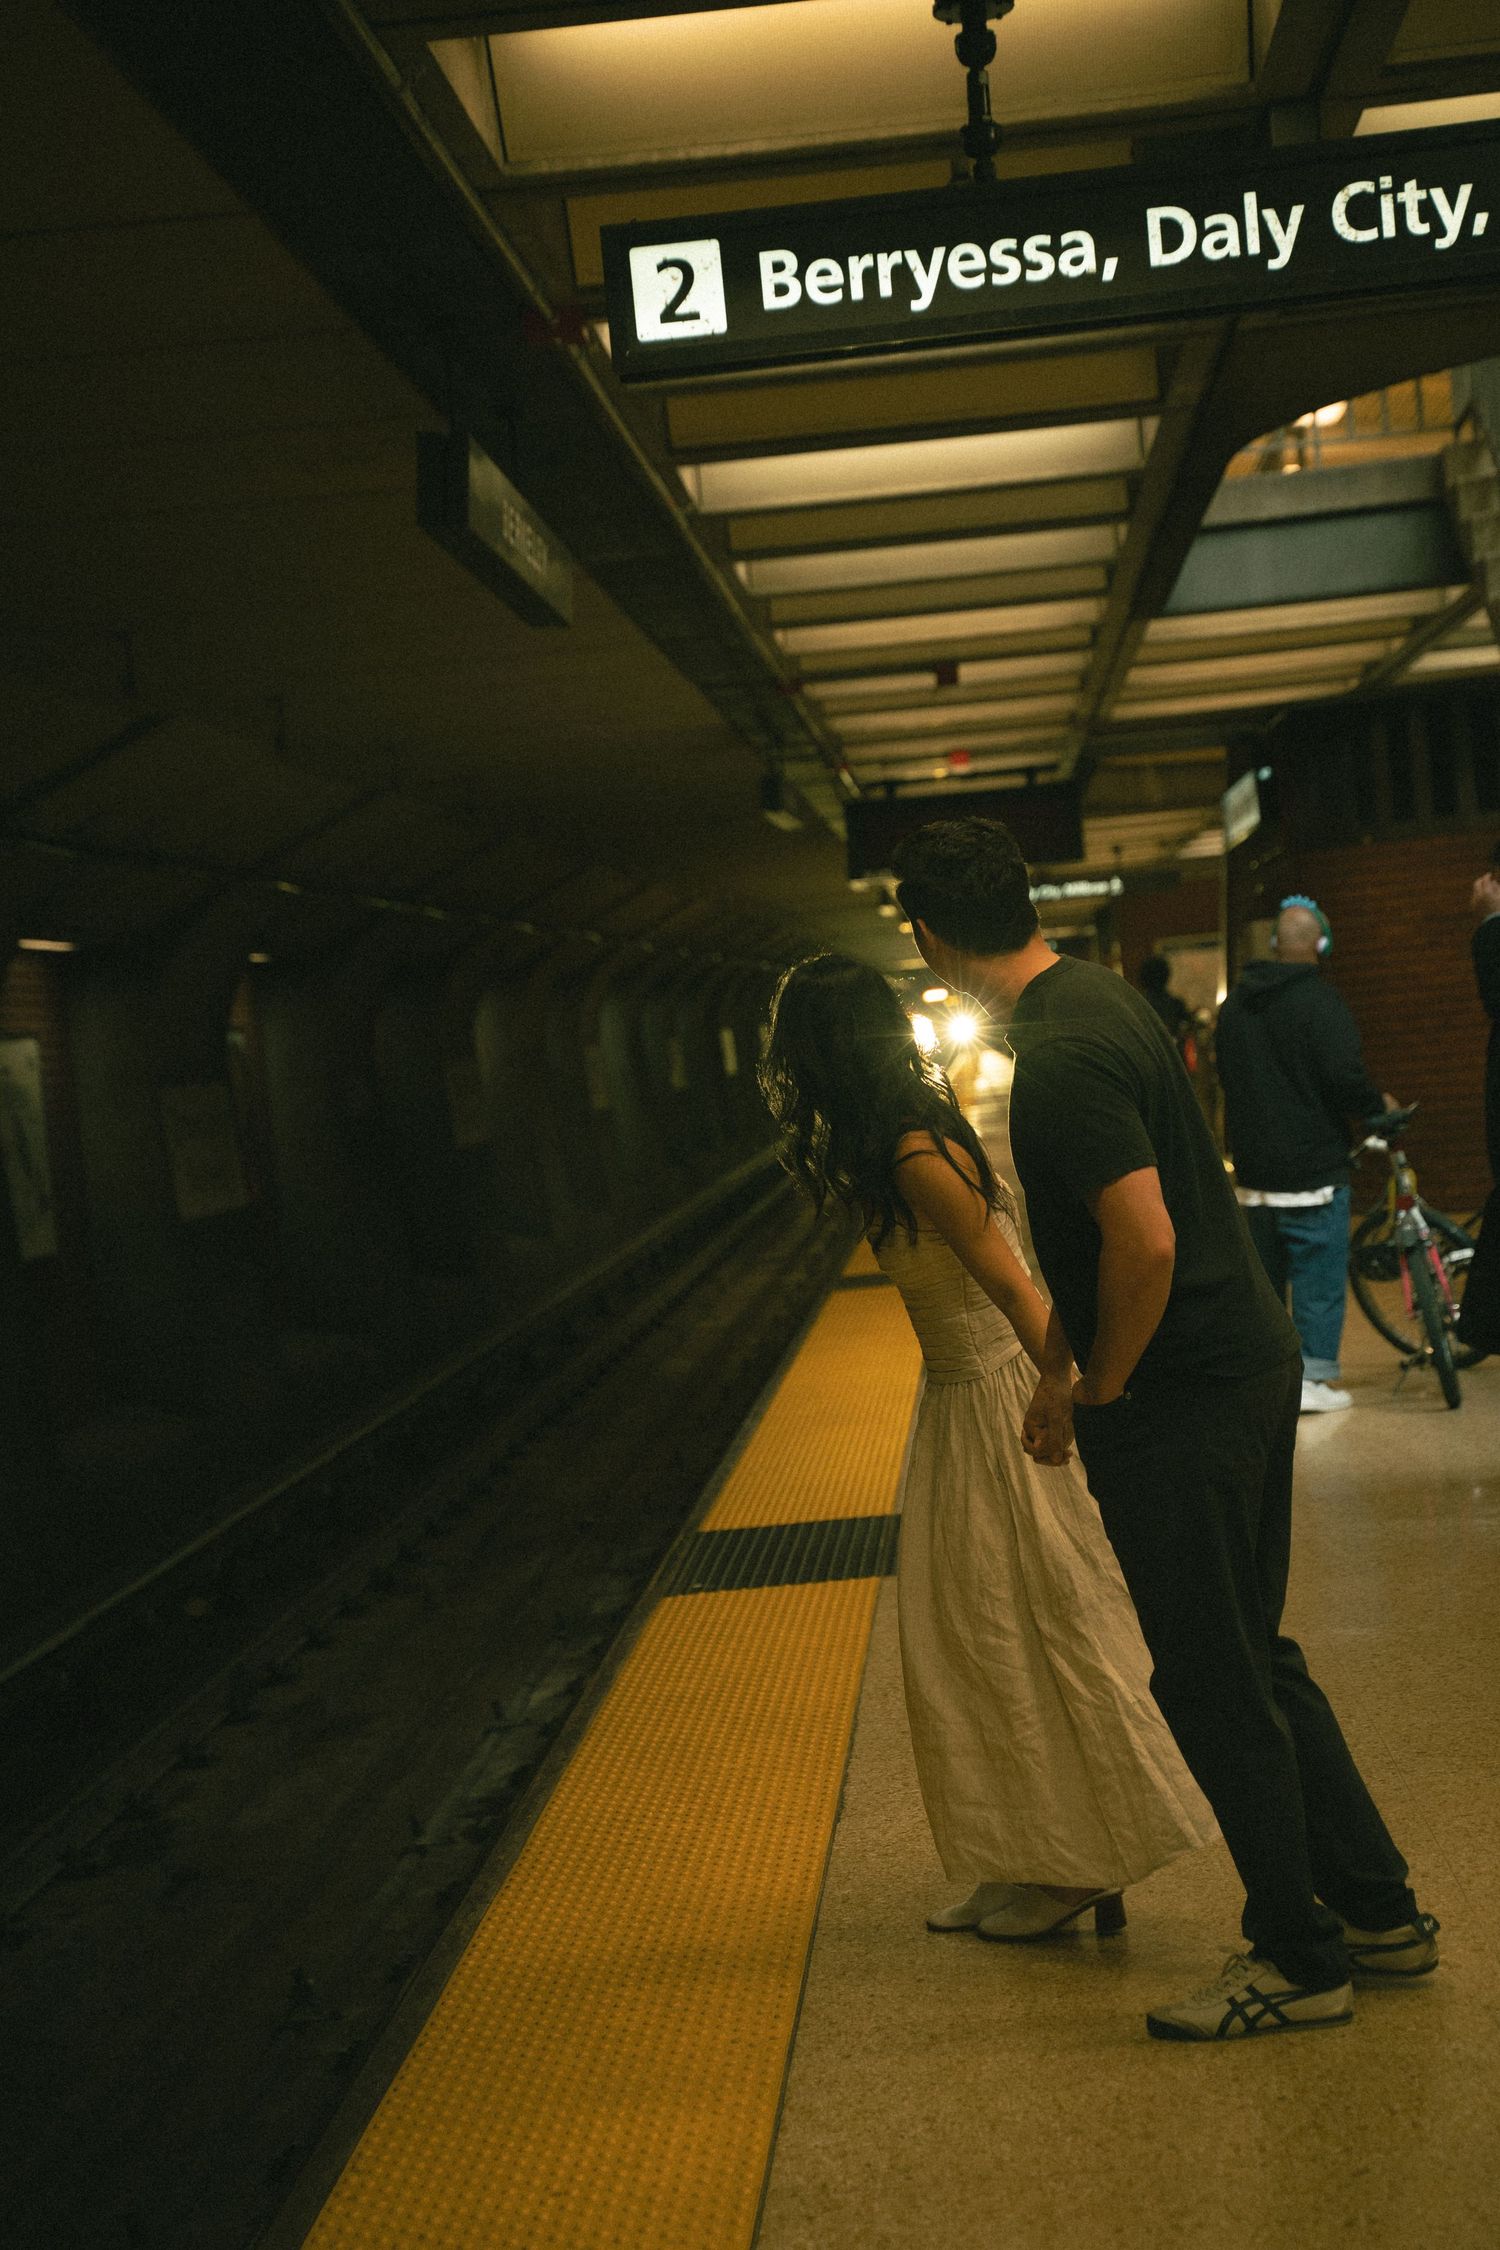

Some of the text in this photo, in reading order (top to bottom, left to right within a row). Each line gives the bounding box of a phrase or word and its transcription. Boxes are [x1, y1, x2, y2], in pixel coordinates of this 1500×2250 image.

[656, 175, 1490, 324] 2 Berryessa, Daly City,
